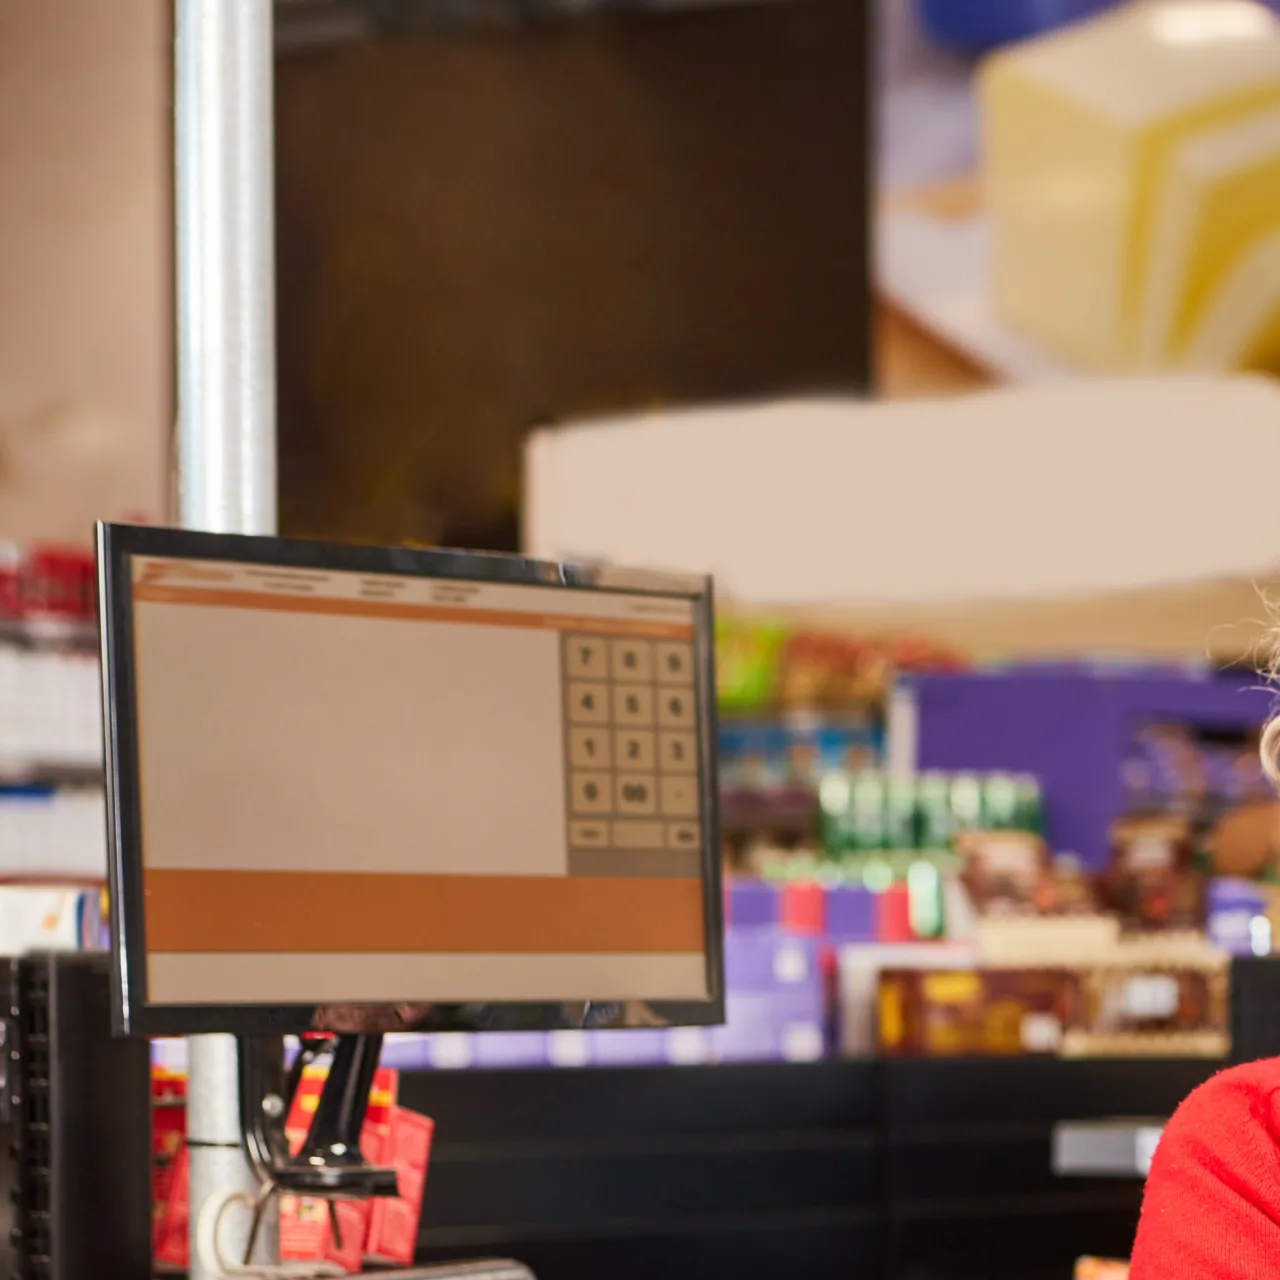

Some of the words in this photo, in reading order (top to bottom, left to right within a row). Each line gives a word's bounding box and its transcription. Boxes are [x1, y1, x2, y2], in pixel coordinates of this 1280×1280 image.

[579, 646, 592, 666] 7
[580, 692, 595, 711] 4
[583, 737, 596, 757] 1
[628, 739, 641, 760] 2
